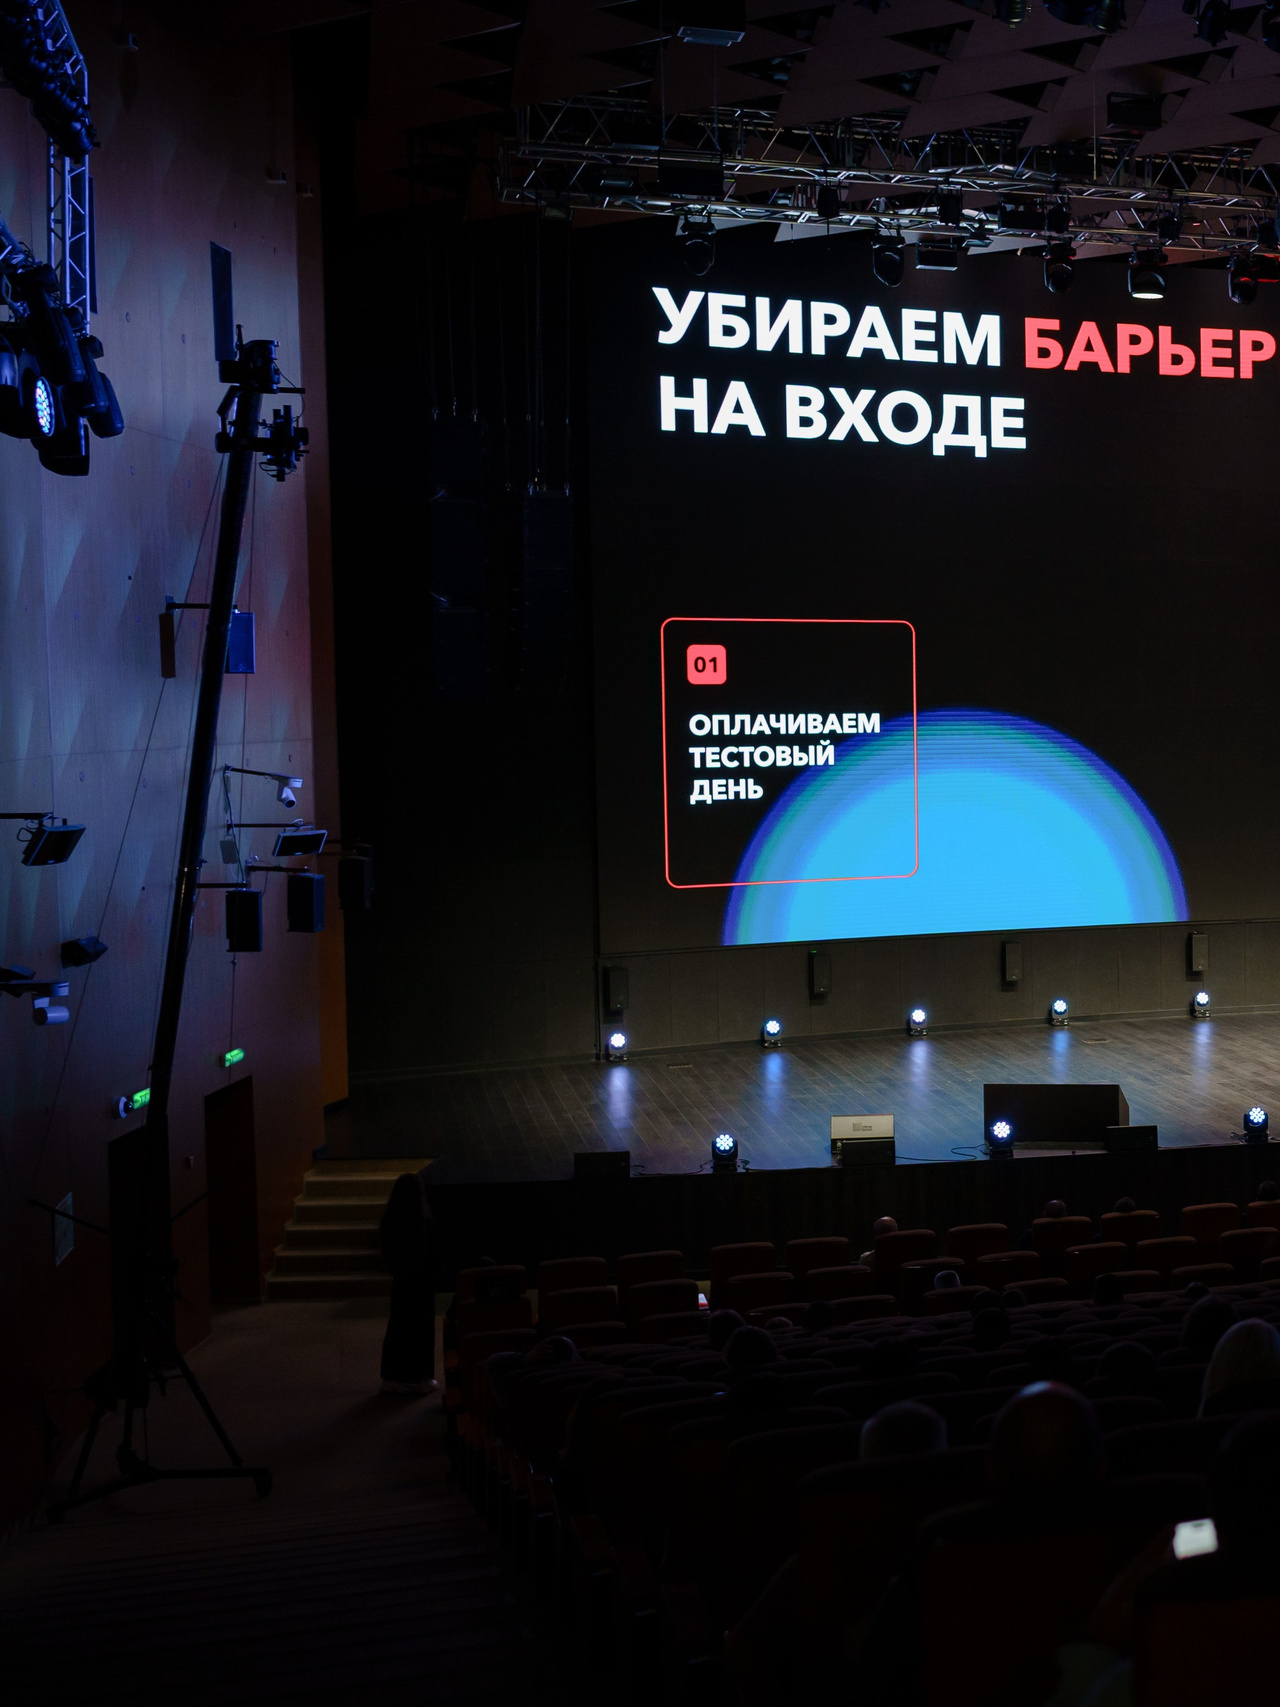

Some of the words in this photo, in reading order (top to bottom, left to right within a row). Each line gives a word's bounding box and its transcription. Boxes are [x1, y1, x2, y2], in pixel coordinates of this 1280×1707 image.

[651, 286, 1001, 367] УБИРАЕМ
[660, 375, 767, 437] НА
[785, 384, 1027, 458] ВХОДЕ
[693, 656, 718, 673] 01
[688, 712, 881, 736] ОПЛАЧИВАЕМ
[688, 739, 835, 769] ТЕСТОВЫЙ
[689, 778, 764, 805] ДЕНЬ
